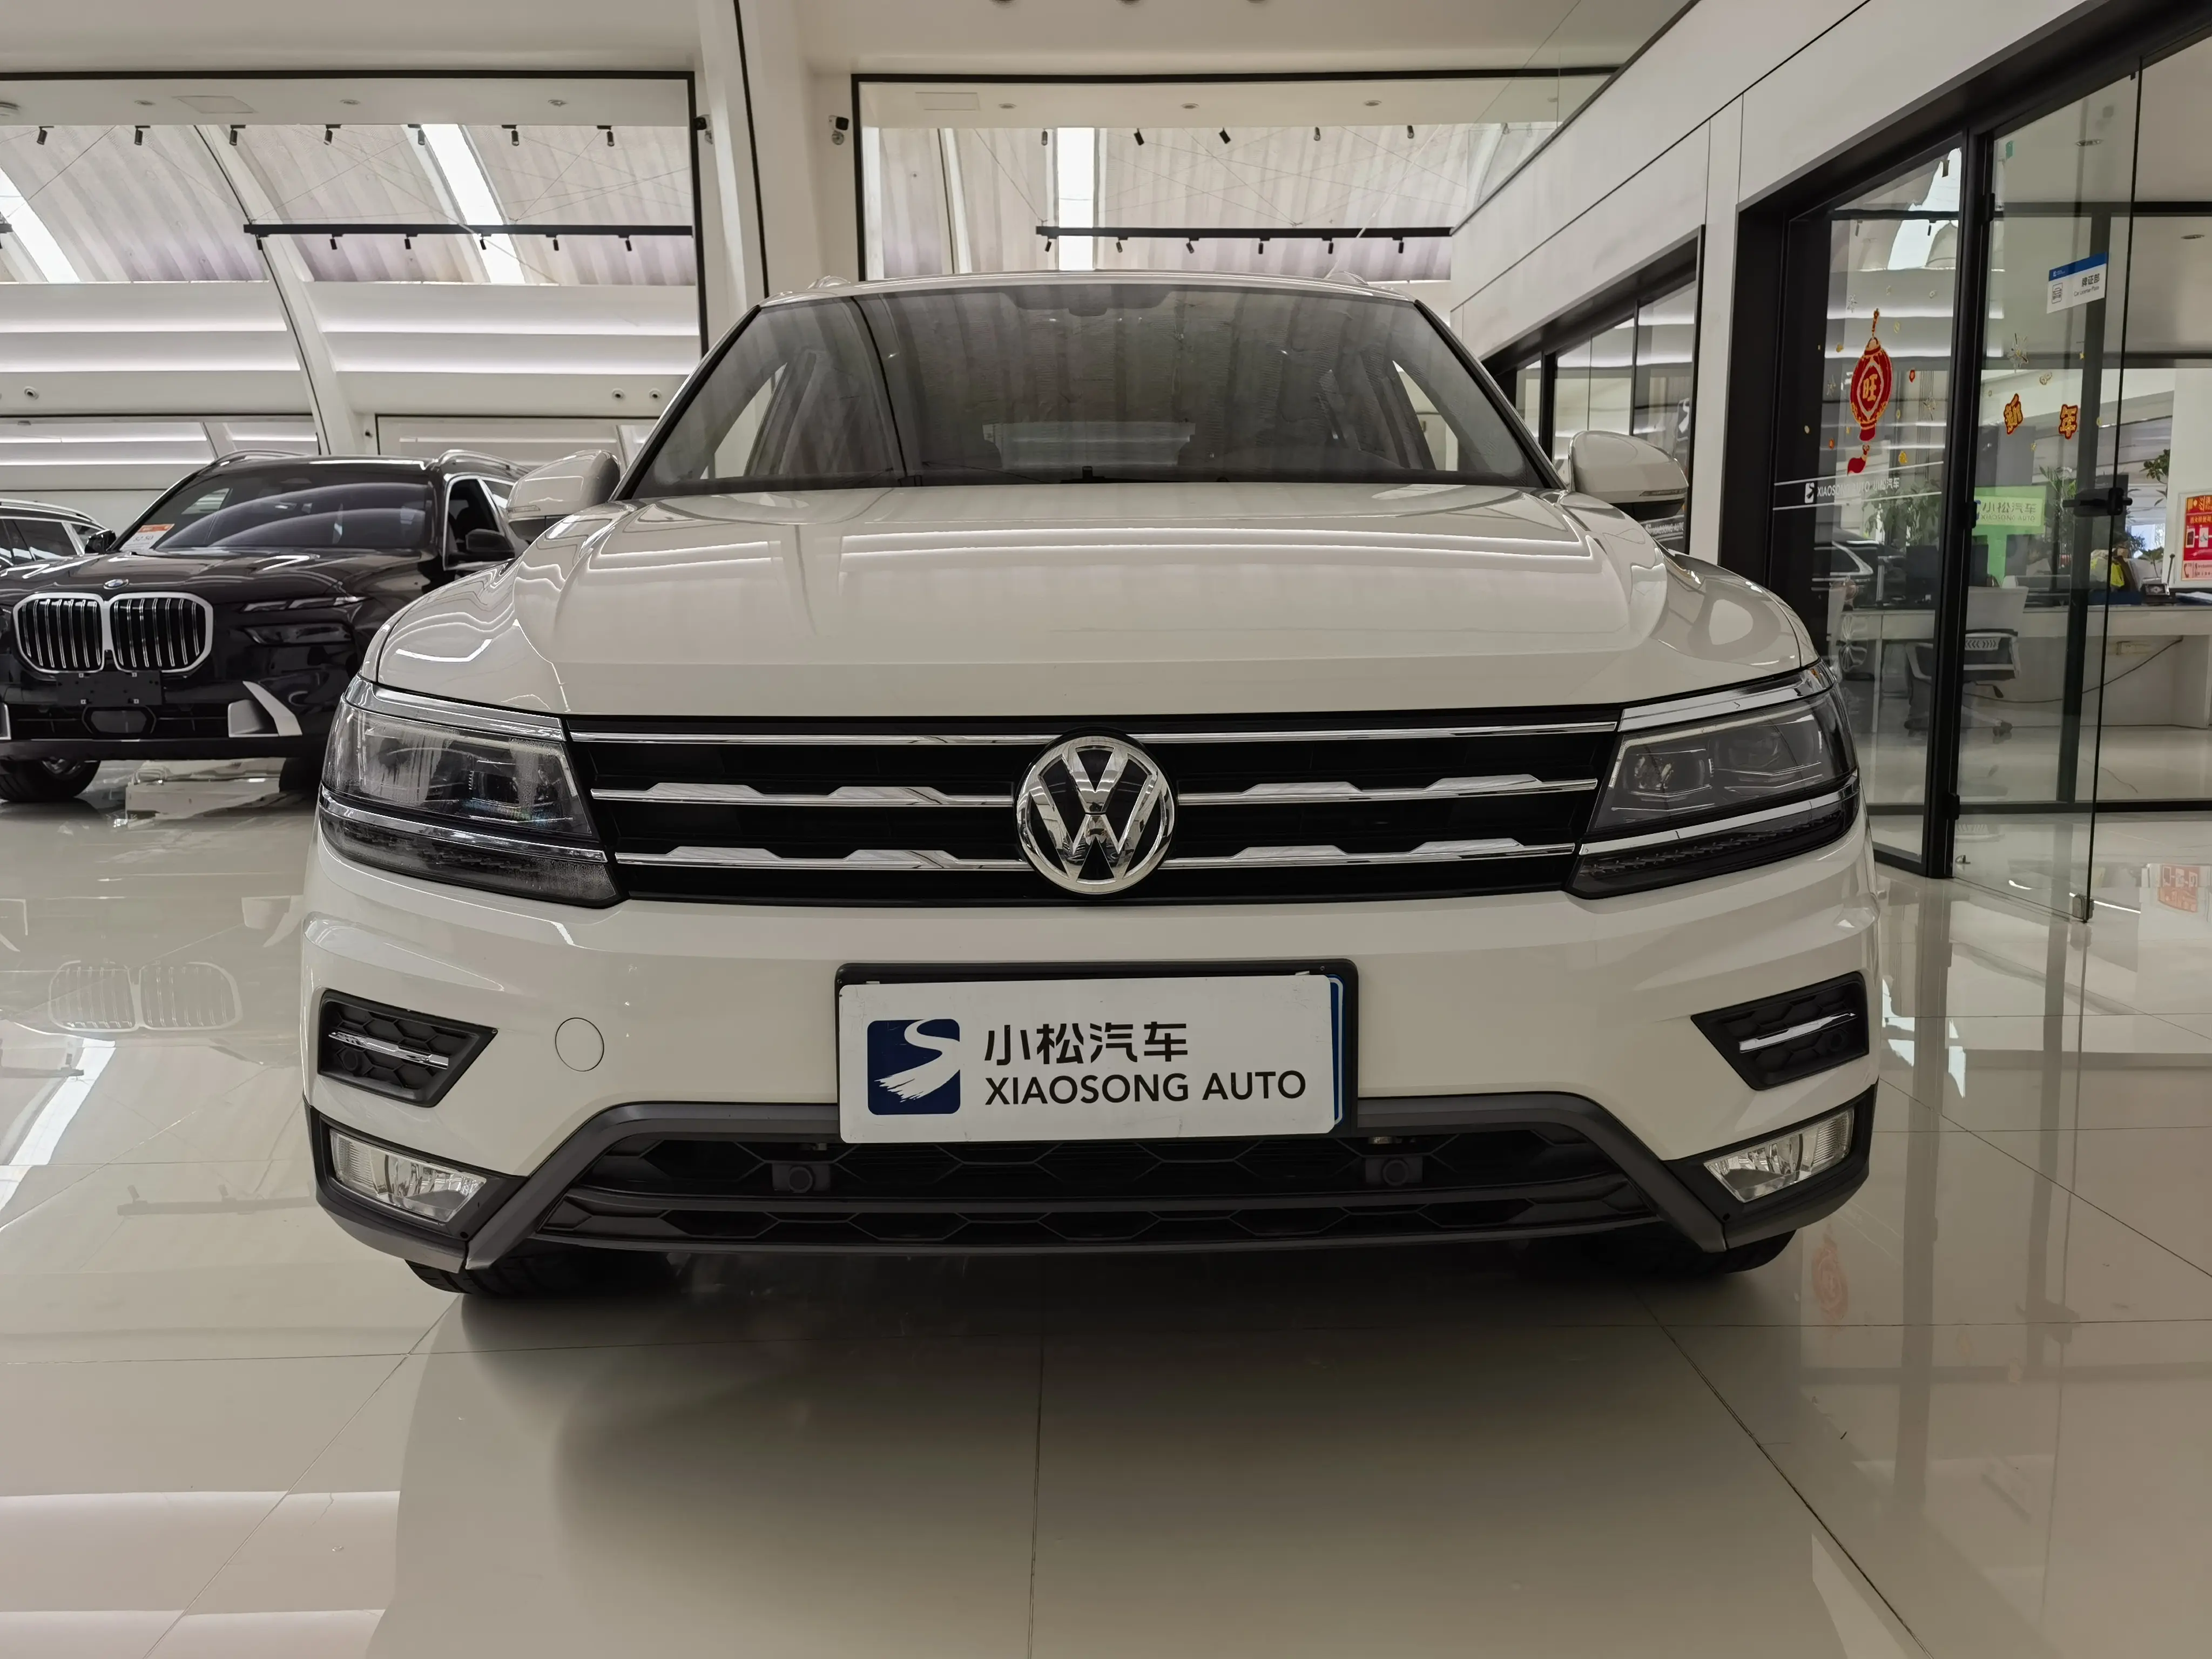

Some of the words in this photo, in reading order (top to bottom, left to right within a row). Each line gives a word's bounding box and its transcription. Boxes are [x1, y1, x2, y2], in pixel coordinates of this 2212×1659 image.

[1863, 373, 1878, 402] 旺
[1817, 483, 1850, 497] XIAOSON
[1982, 501, 2036, 514] 小松汽车
[984, 1021, 1189, 1066] 小松汽车
[985, 1073, 1189, 1106] XIAOSONG
[1202, 1070, 1306, 1101] AUTO
